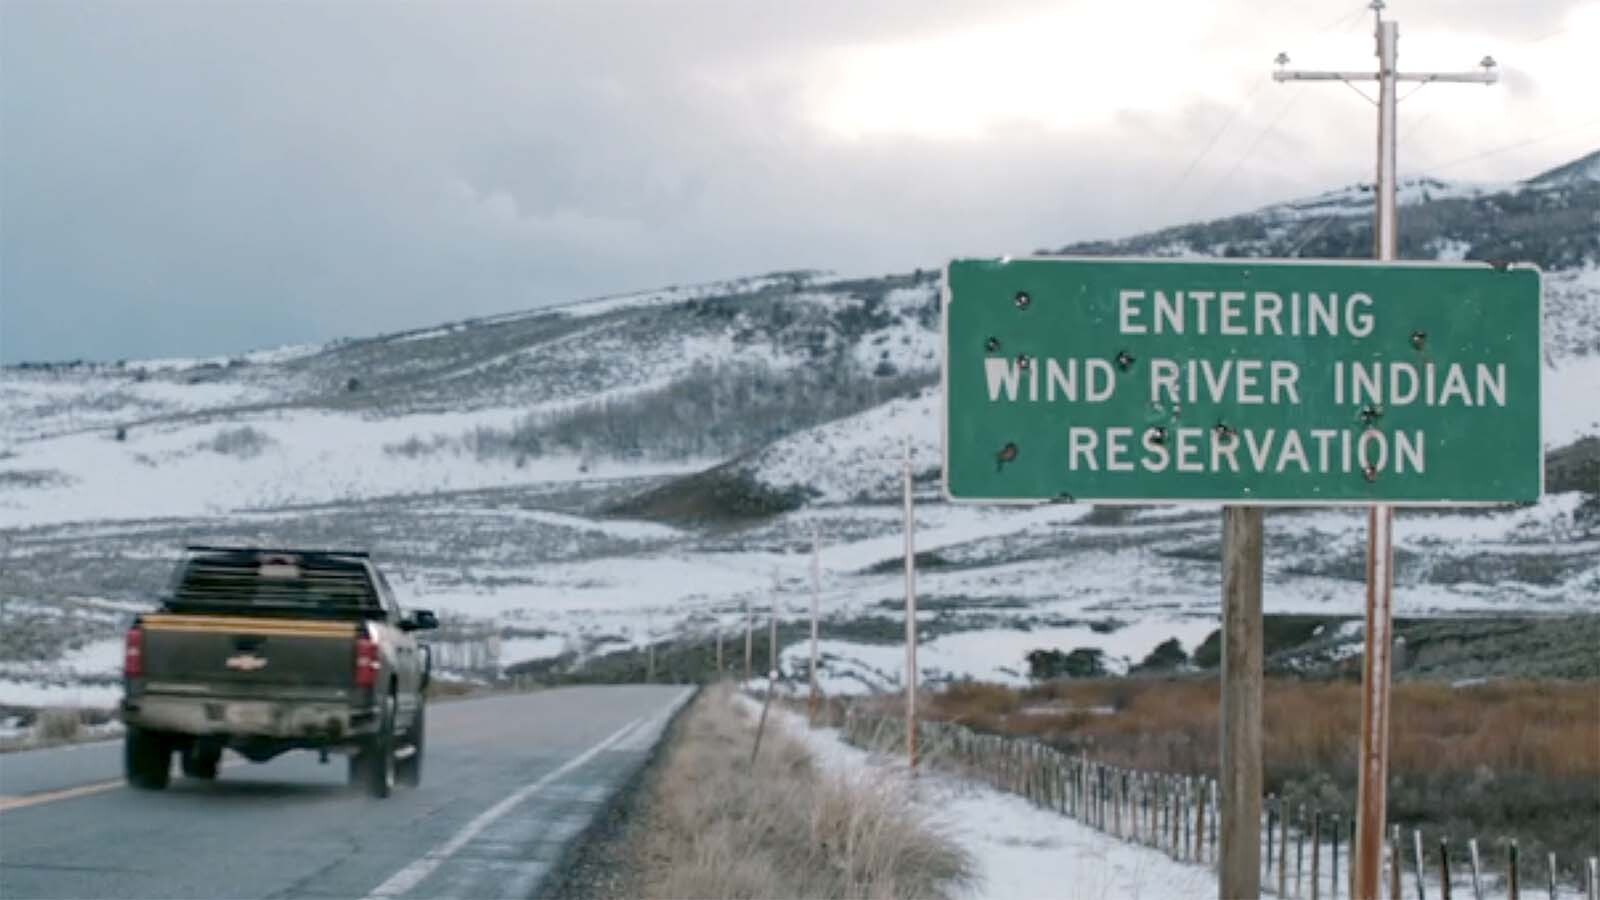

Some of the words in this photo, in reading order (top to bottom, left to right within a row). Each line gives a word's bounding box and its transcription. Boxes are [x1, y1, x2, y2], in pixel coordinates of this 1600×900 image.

[1119, 290, 1374, 337] ENTERING
[984, 357, 1115, 403] WIND
[1150, 359, 1300, 404] RIVER
[1335, 361, 1507, 407] INDIAN
[1068, 427, 1425, 474] RESERVATION
